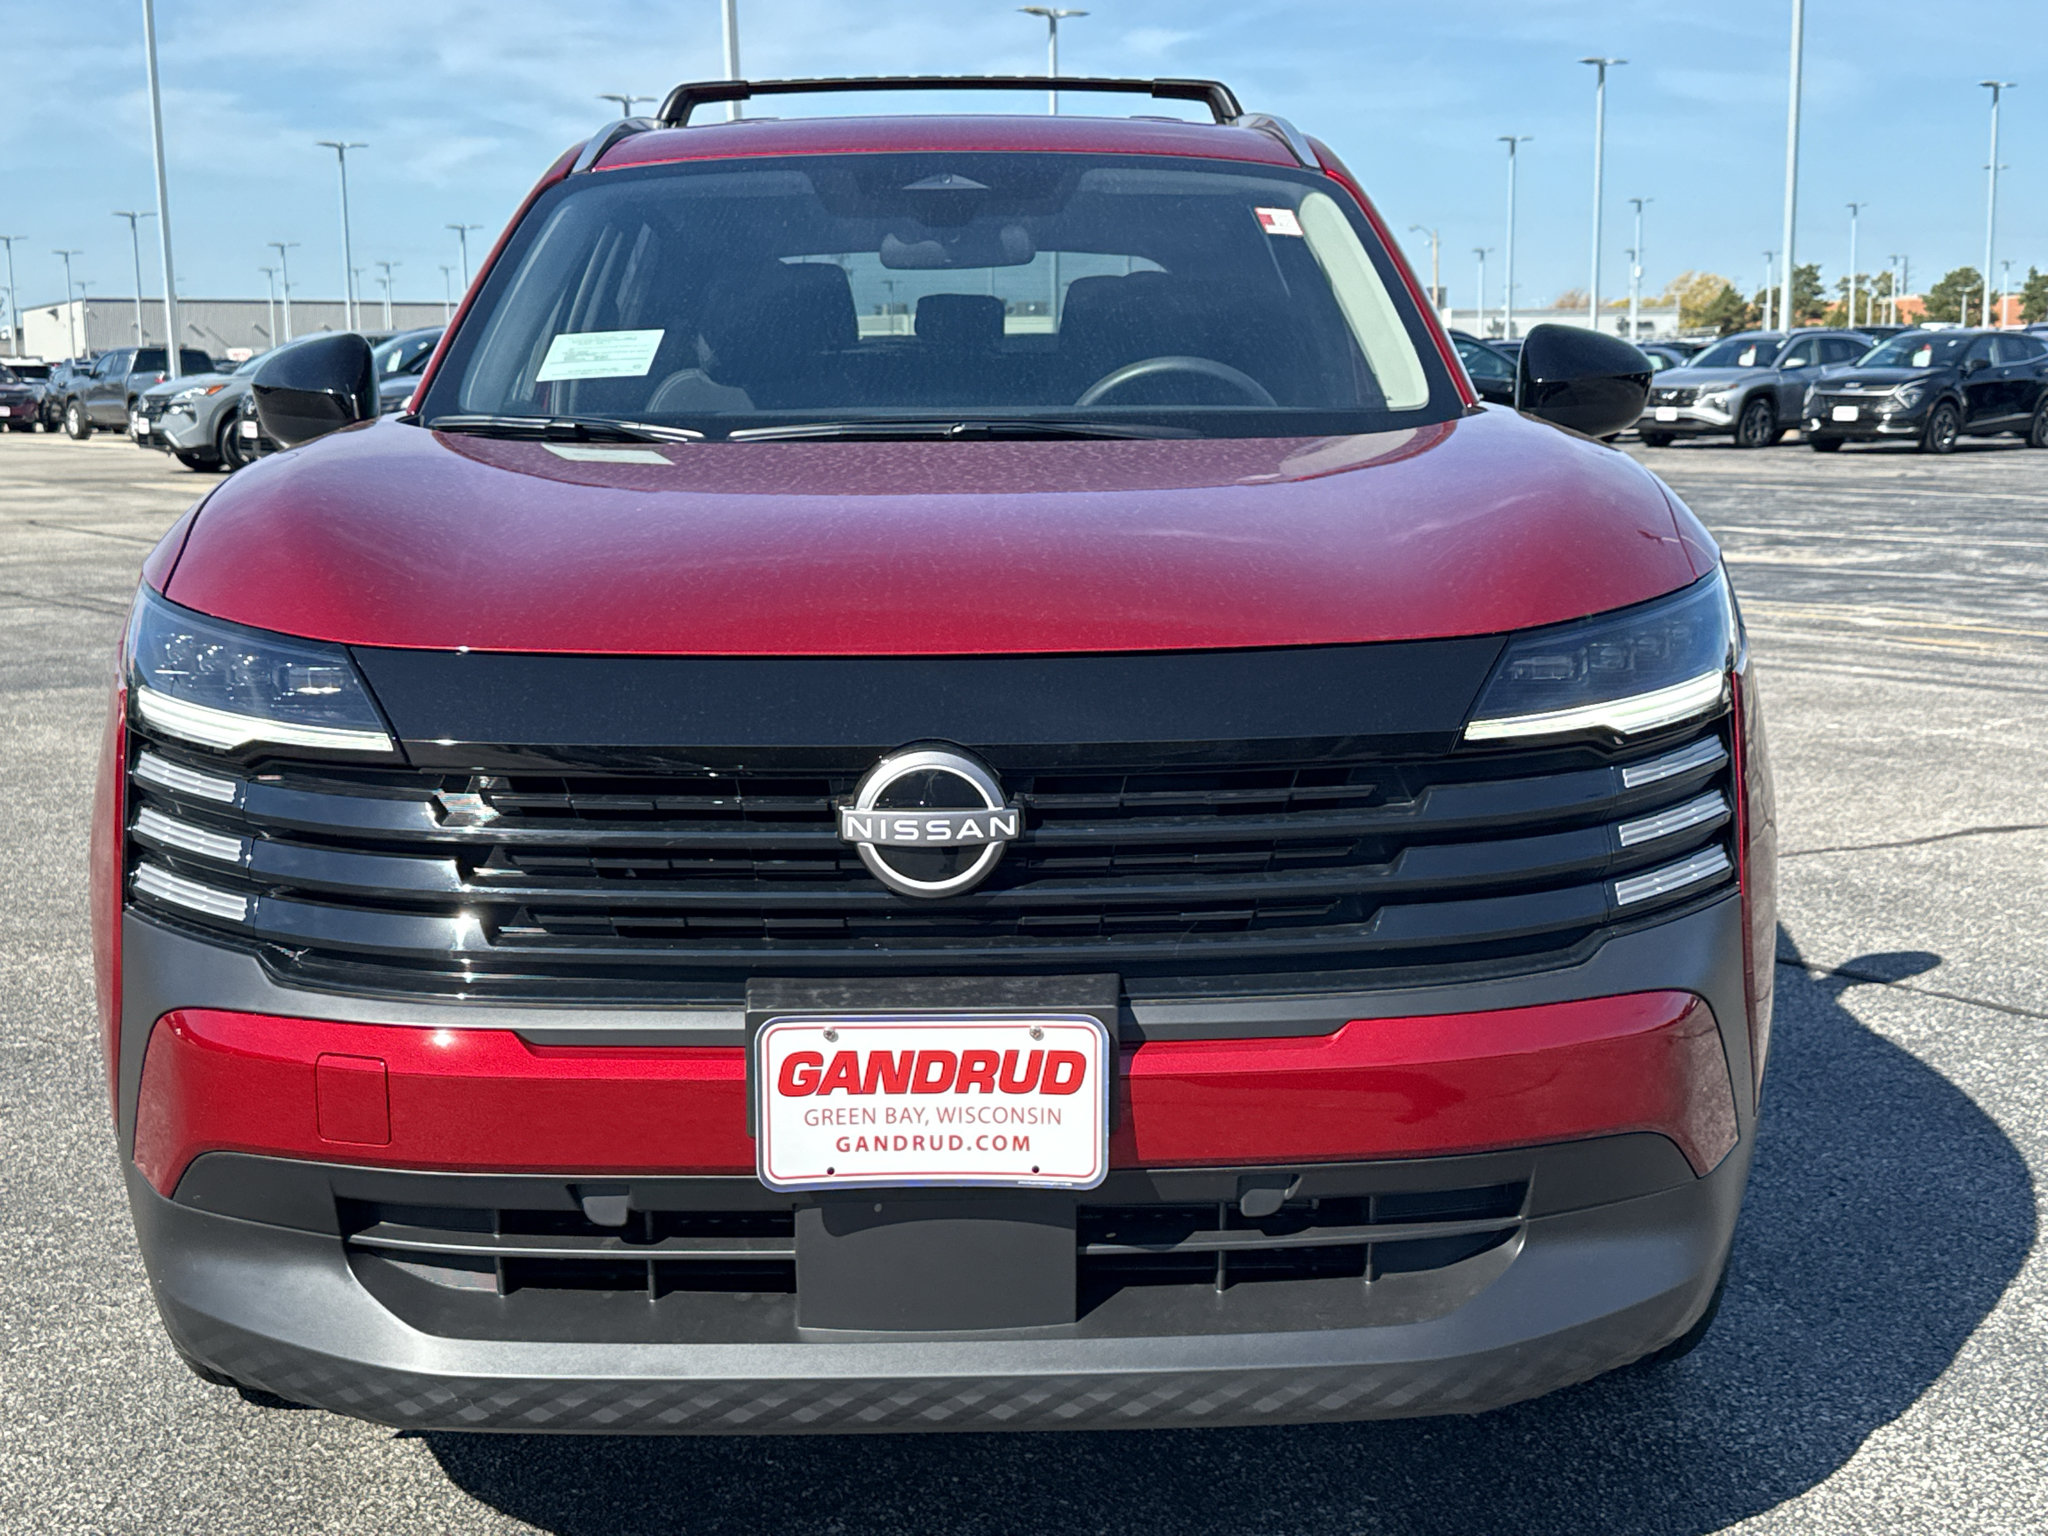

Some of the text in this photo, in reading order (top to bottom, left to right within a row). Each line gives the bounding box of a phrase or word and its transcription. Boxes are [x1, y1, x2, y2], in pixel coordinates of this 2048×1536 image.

[847, 815, 1016, 840] NISSAN
[777, 1049, 1087, 1097] GANDRUD
[803, 1106, 1062, 1127] GREEN BAY, WISCONSIN
[835, 1134, 1031, 1153] GANDRUD.COM
